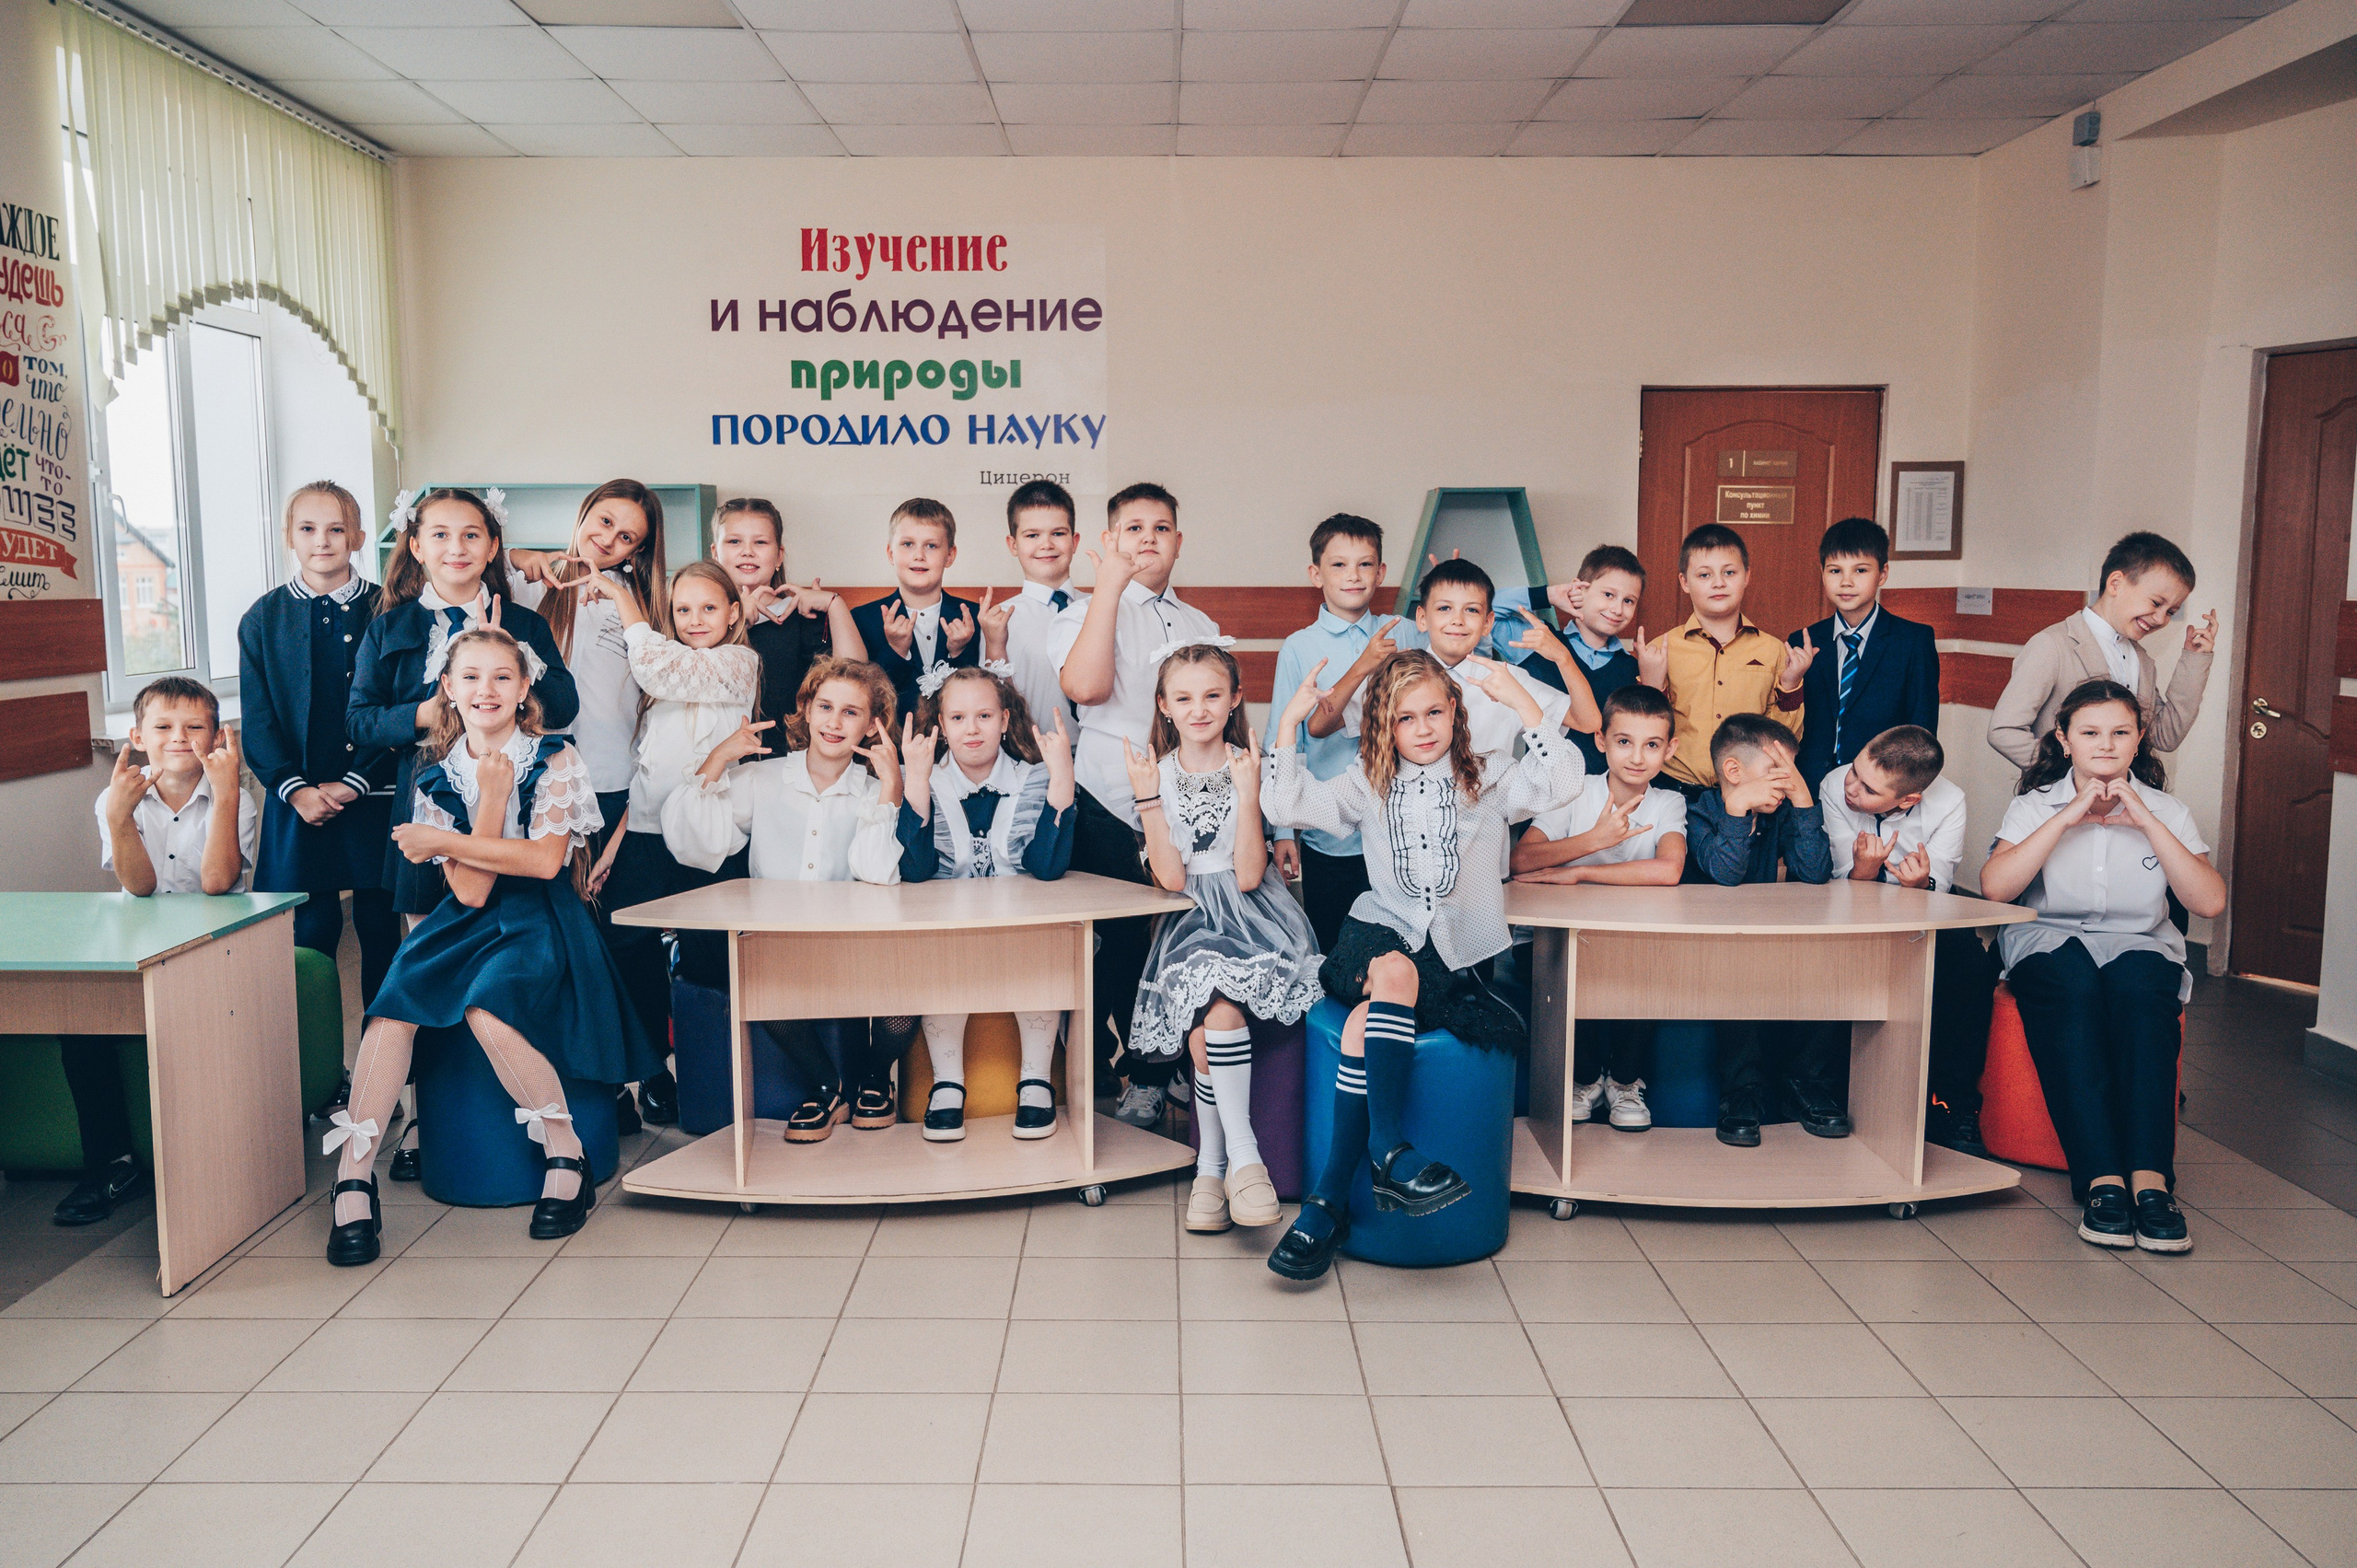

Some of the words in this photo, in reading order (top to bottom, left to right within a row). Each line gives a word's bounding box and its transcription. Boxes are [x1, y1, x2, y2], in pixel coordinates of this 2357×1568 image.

[800, 227, 1008, 281] Изучение
[711, 299, 738, 332] и
[759, 288, 1103, 340] наблюдение
[791, 359, 1022, 401] природы
[0, 399, 72, 460] ельно
[712, 414, 950, 447] ПОРОДИЛО
[969, 413, 1106, 450] НАУКУ
[980, 470, 1070, 486] Цицерон
[1728, 458, 1734, 469] 1
[0, 485, 76, 542] ШЕЕ
[1724, 491, 1788, 500] Консультационный
[1746, 502, 1765, 510] пункт
